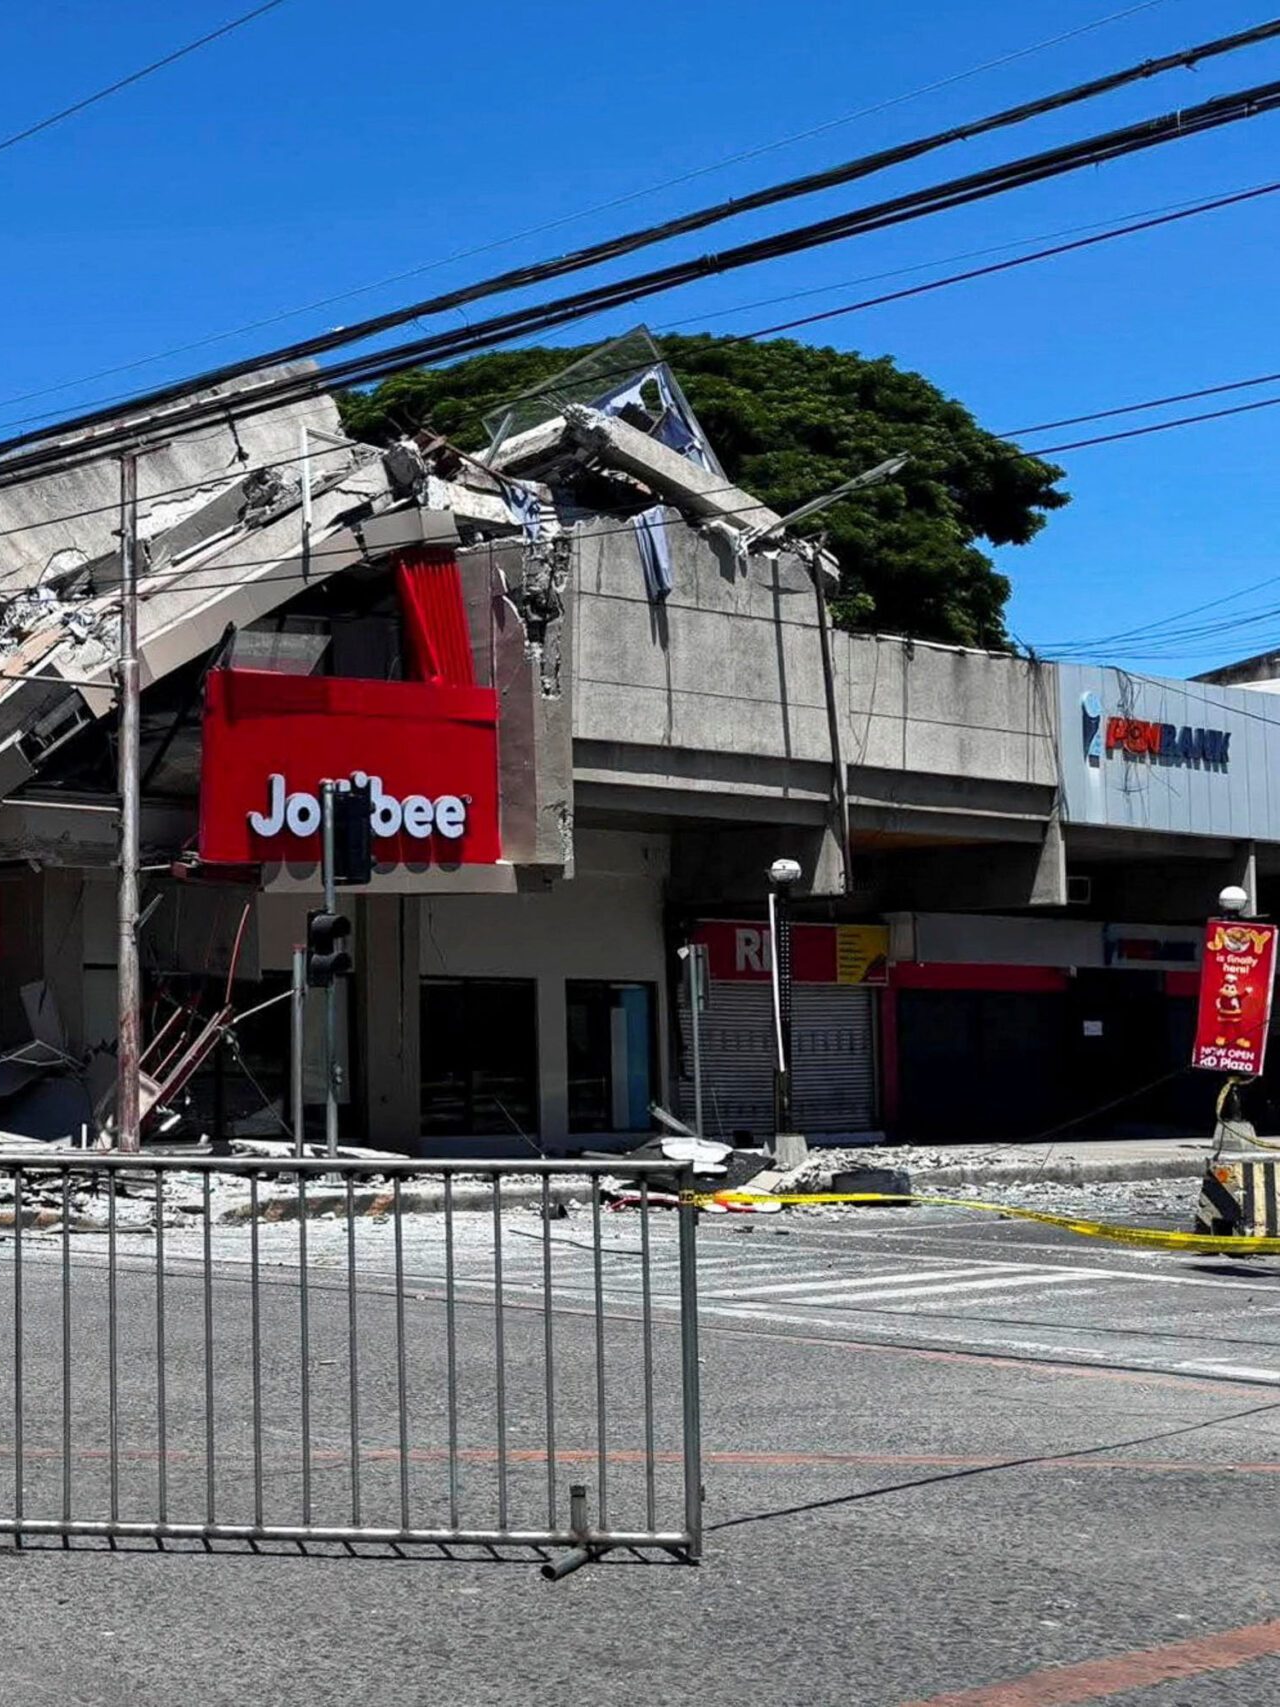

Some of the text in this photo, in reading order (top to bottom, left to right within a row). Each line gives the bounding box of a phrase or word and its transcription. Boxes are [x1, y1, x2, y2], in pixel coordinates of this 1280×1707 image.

[246, 770, 466, 838] Jobee
[1226, 954, 1259, 968] finally
[1220, 1057, 1253, 1072] Plaza
